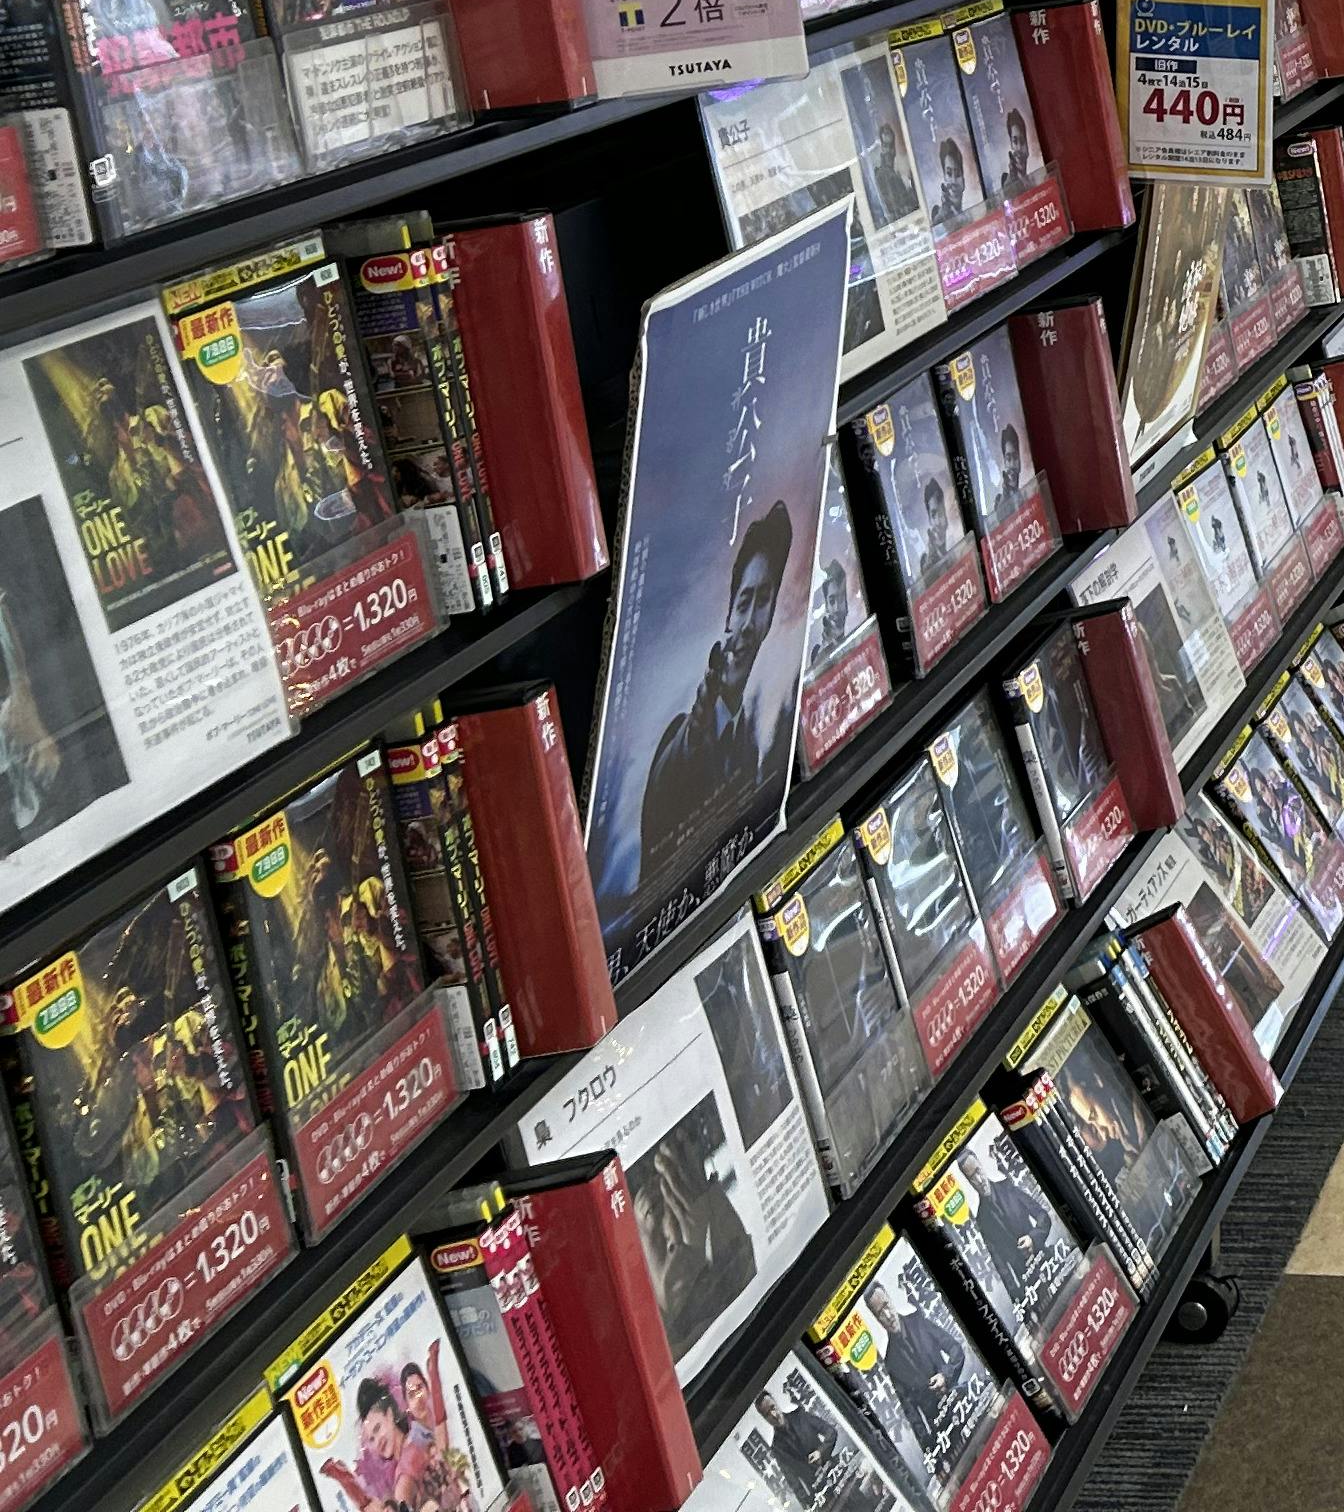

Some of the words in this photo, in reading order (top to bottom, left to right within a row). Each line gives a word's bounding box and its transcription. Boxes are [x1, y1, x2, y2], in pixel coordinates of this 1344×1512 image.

[1029, 9, 1051, 46] 新作
[1134, 18, 1257, 40] DVD・ブルーレイ
[1136, 34, 1199, 52] レンタル
[669, 58, 733, 77] TSUTAYA
[1154, 59, 1179, 71] 旧作
[1142, 88, 1245, 127] 440円
[1200, 128, 1252, 142] 税込484円
[535, 220, 556, 274] 新作
[366, 262, 407, 280] New!
[190, 307, 235, 338] 最新作
[1037, 310, 1059, 347] 新作
[81, 507, 130, 557] ONE
[92, 539, 154, 594] LOVE
[353, 578, 418, 633] 1,320円
[536, 697, 559, 750] 新作
[246, 818, 286, 858] 最新作
[26, 957, 77, 1005] 最新作
[282, 1032, 331, 1109] ONE
[382, 1057, 444, 1122] 1,320円
[562, 1064, 618, 1124] フクロウ
[603, 1160, 626, 1219] 新作
[80, 1190, 141, 1279] ONE
[197, 1210, 273, 1287] 1,320円
[436, 1248, 477, 1268] New!
